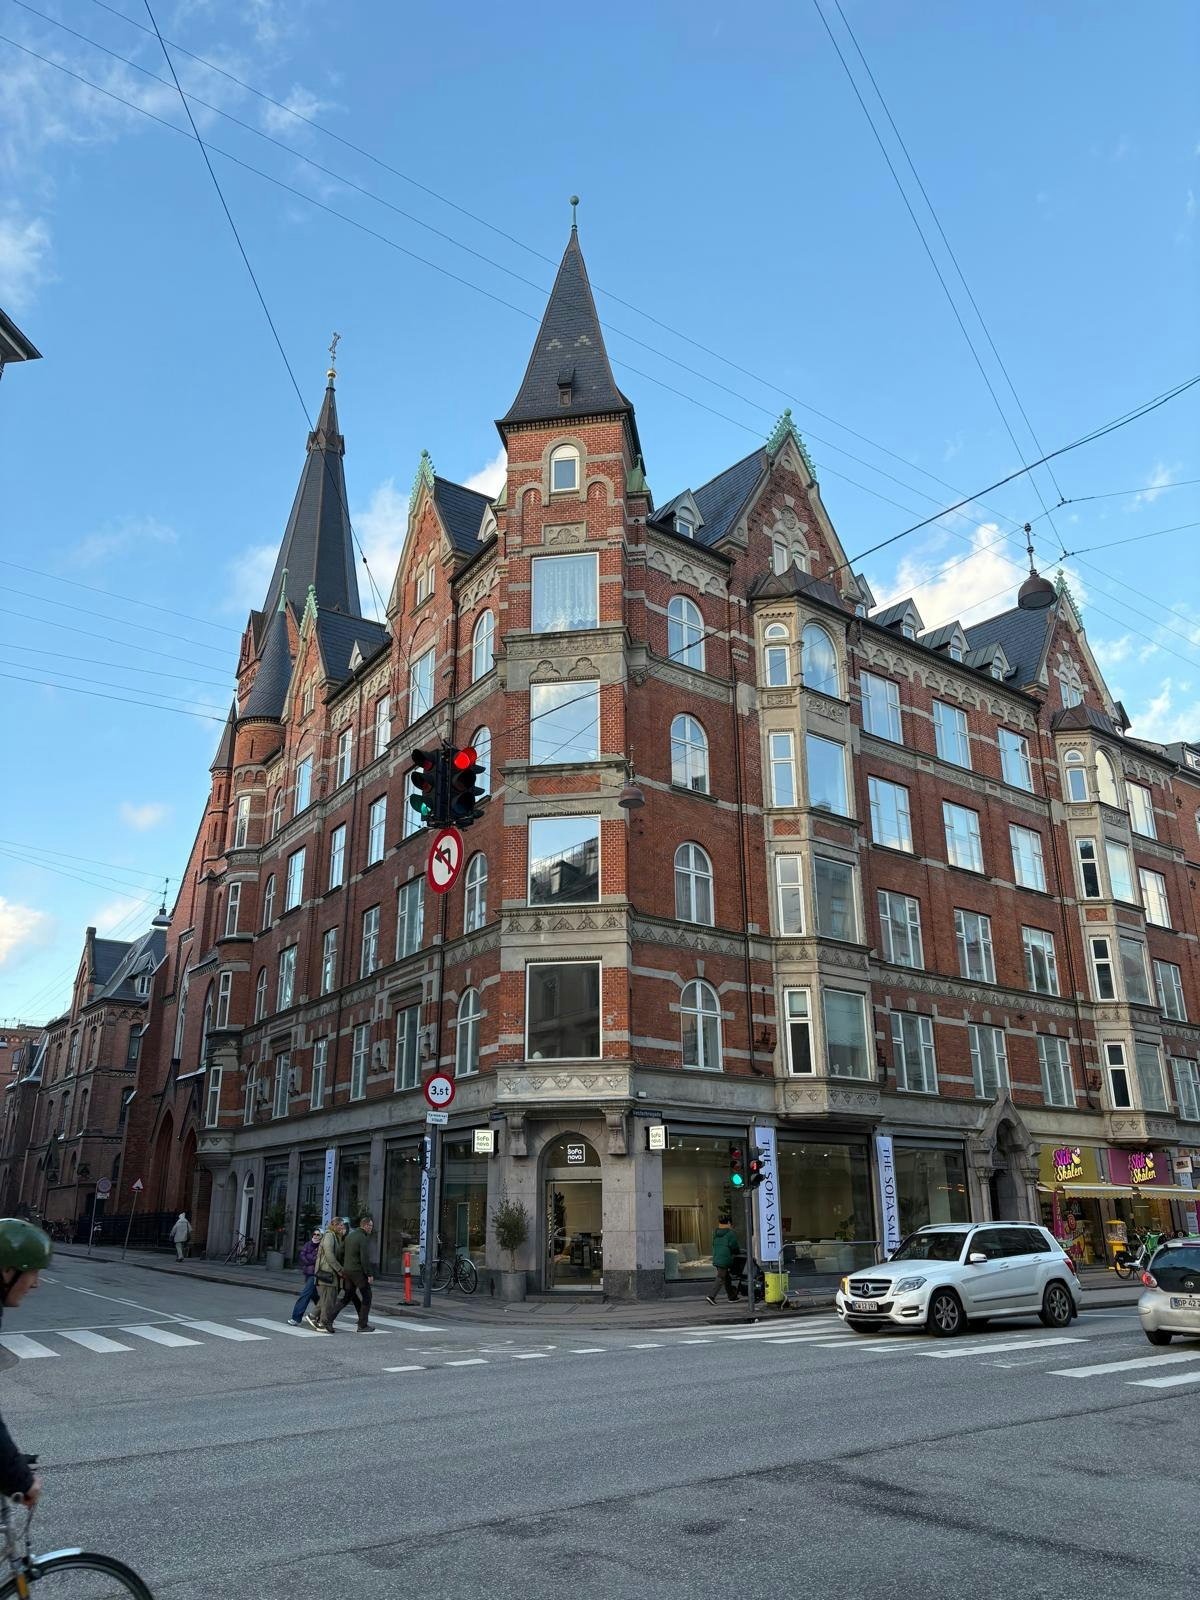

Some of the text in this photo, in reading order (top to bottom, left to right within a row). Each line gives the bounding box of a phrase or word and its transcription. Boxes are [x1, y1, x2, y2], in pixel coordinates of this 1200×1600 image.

[762, 1139, 776, 1249] THE SOFA SALE
[883, 1147, 897, 1249] THE SOFA SALE
[1056, 1162, 1083, 1181] Skålen
[1133, 1166, 1156, 1183] Skålen
